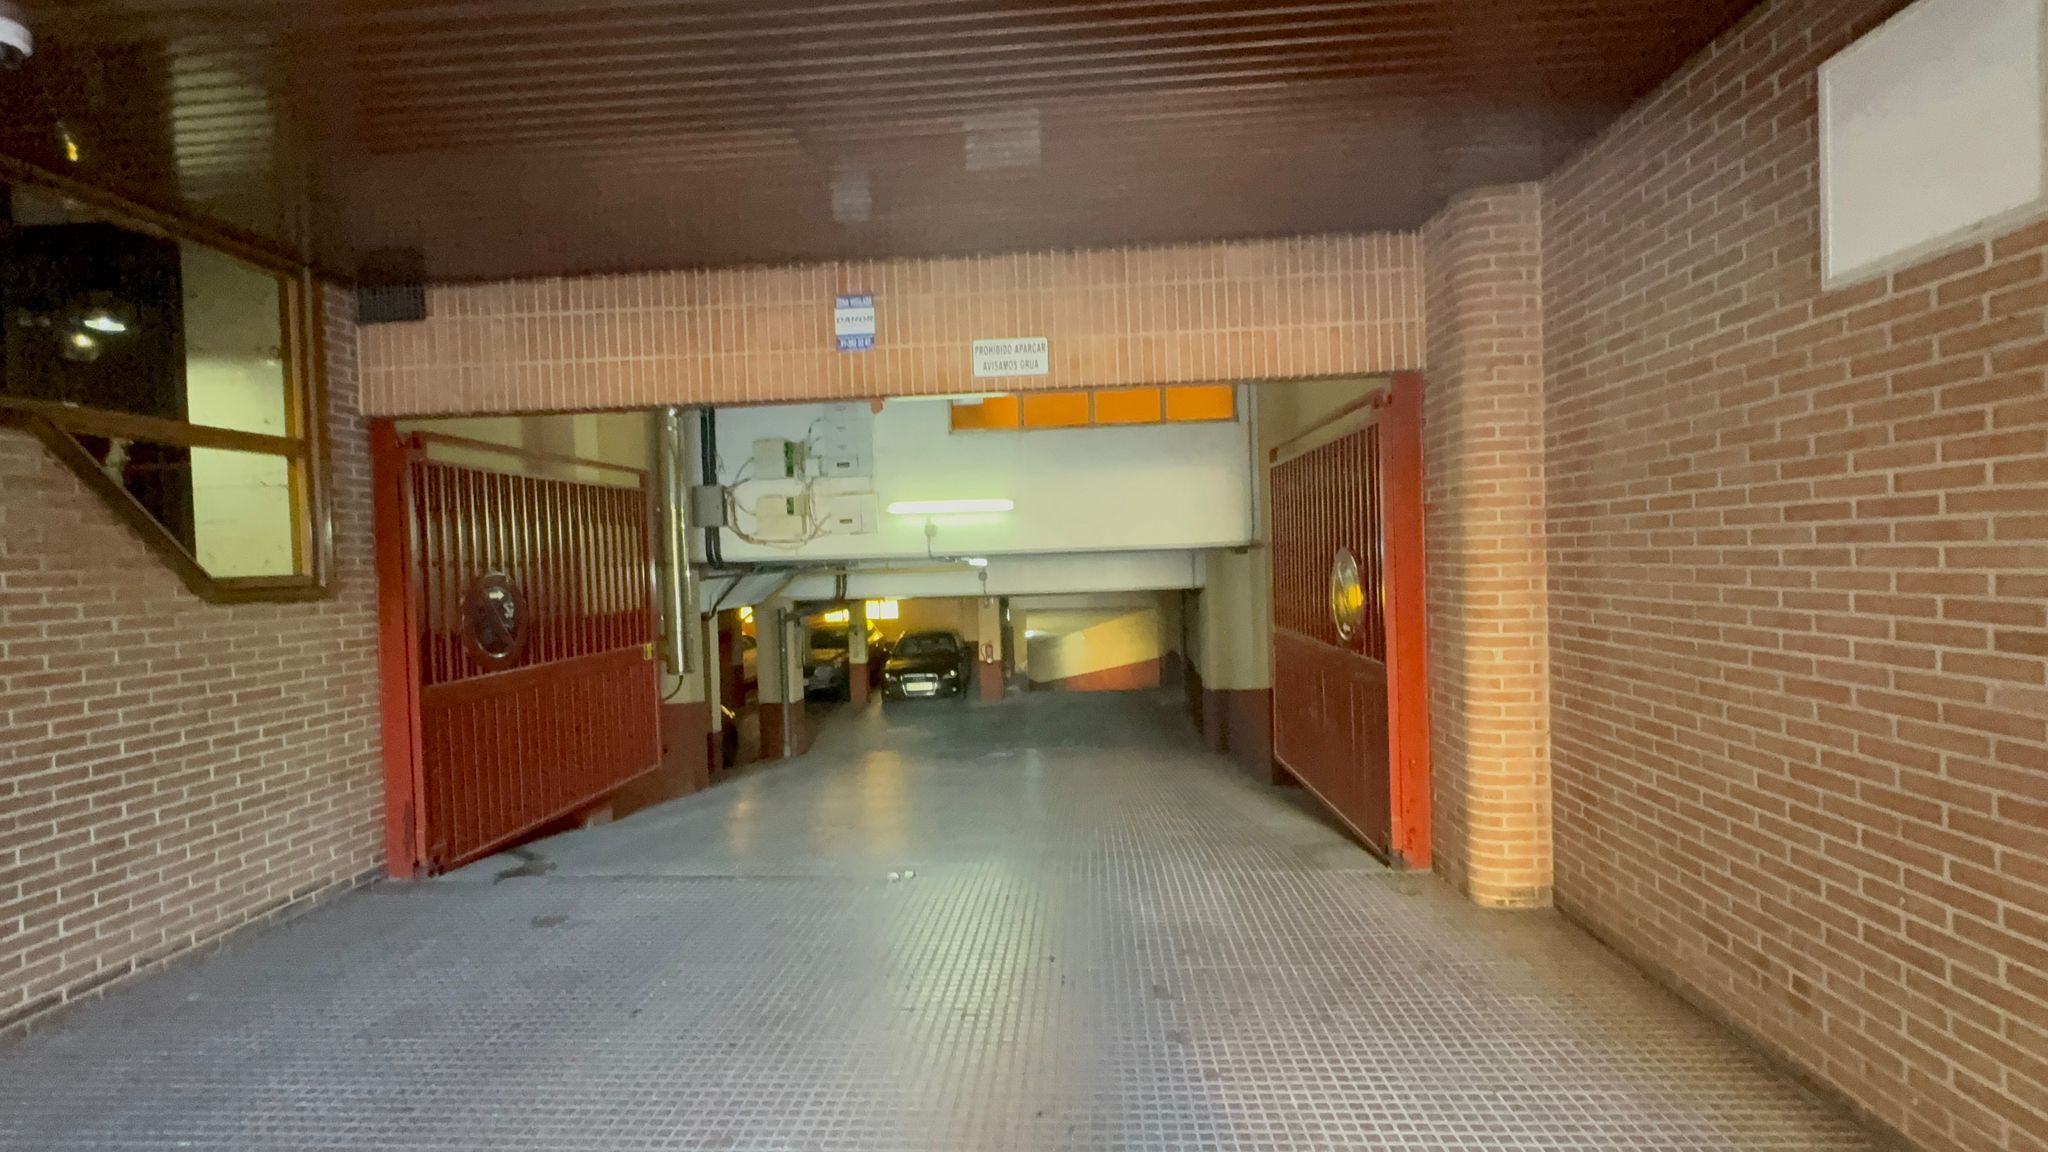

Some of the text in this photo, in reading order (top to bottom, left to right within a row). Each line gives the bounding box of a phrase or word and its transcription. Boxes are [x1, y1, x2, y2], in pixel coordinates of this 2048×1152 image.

[975, 343, 1046, 355] PROHIBIDO APARCAR
[983, 359, 1039, 371] AVISAMOS GRUA
